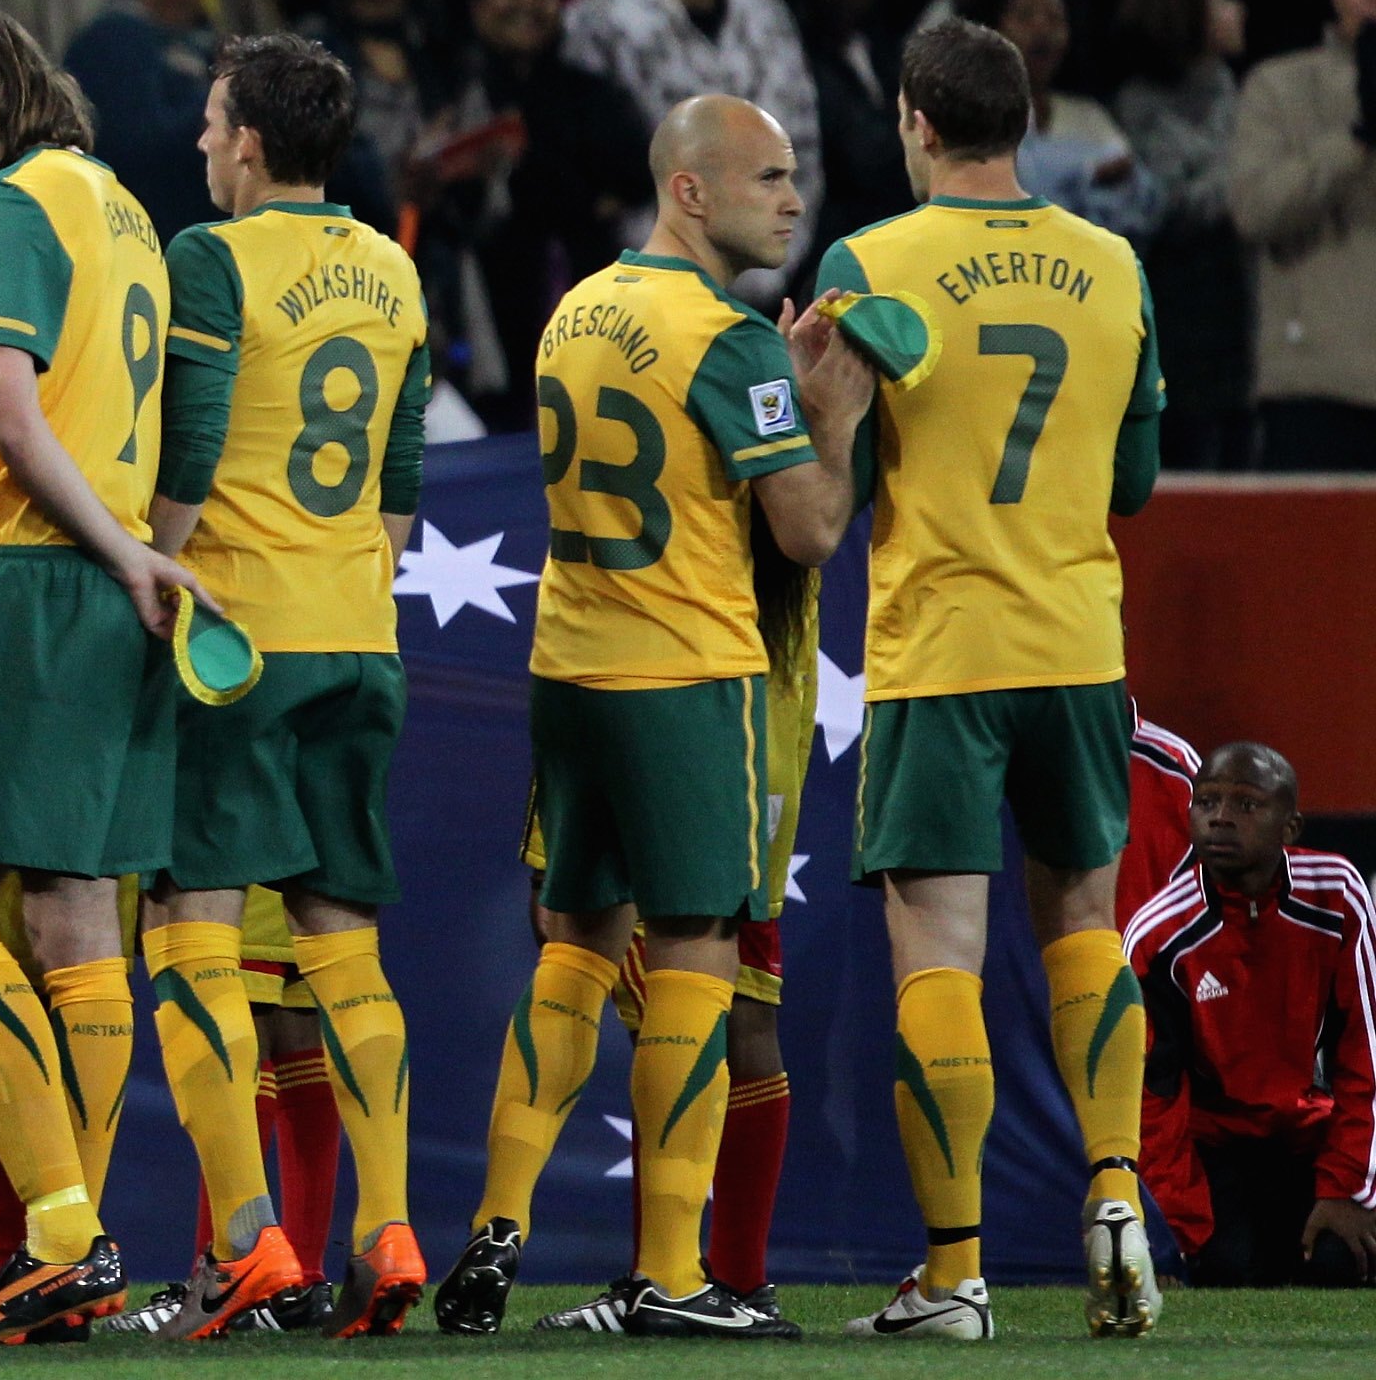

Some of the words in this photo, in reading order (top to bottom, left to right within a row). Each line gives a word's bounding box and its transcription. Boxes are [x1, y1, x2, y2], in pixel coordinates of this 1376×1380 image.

[276, 264, 404, 329] WILKSHIRE
[543, 304, 660, 375] BRESCIANO
[937, 252, 1094, 304] EMERTON
[116, 282, 160, 465] 9
[287, 335, 379, 518] 8
[978, 323, 1070, 505] 7
[538, 374, 672, 570] 23
